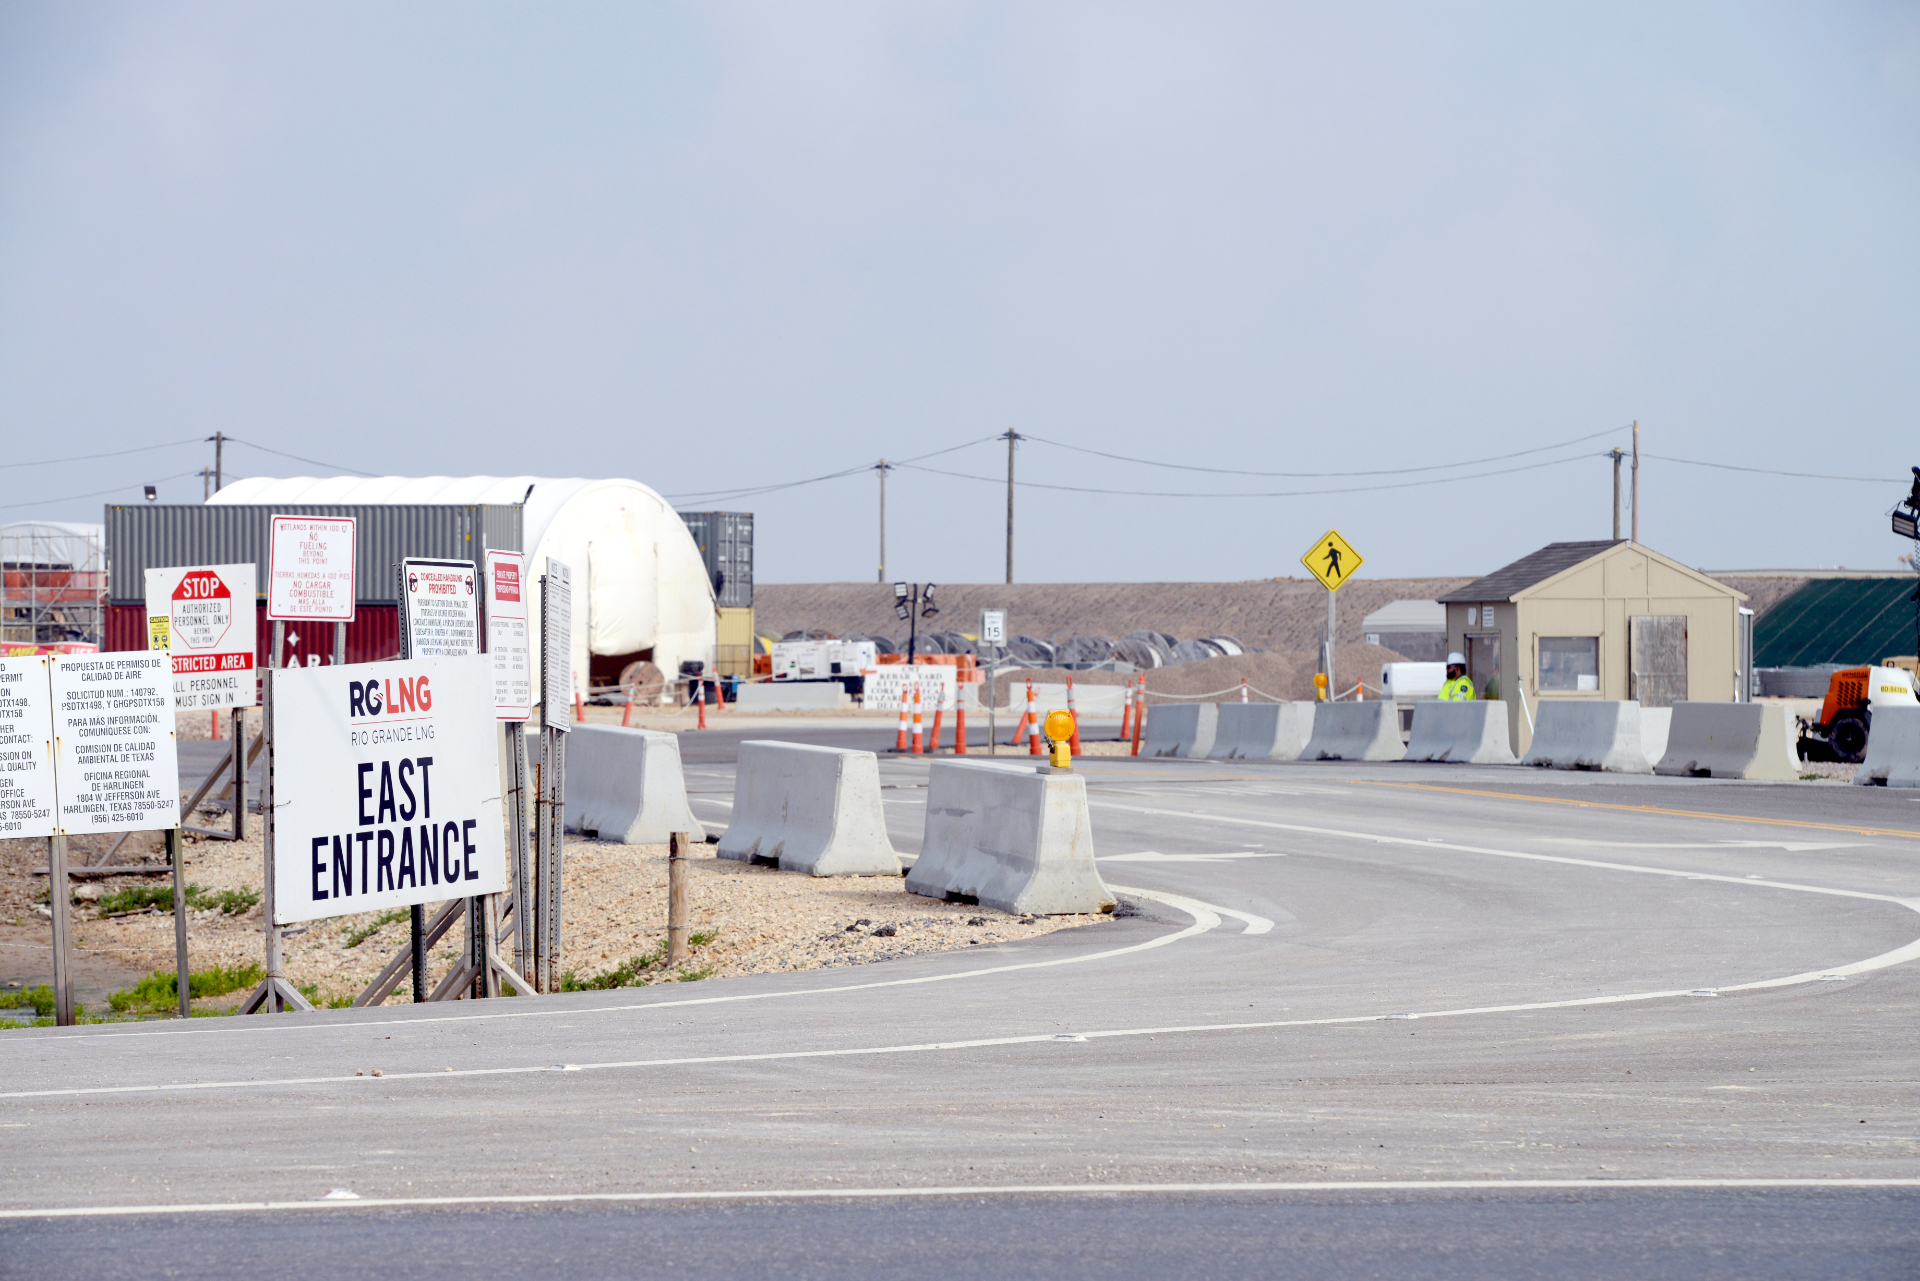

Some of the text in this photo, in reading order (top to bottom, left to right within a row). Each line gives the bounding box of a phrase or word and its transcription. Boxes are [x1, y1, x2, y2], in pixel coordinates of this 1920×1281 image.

[300, 542, 327, 551] FUELING
[183, 577, 220, 598] STOP
[305, 581, 331, 589] CARGAR
[428, 584, 456, 594] PROHIBITED
[289, 590, 334, 598] COMBUSTIBLE
[182, 603, 222, 614] AUTHORIZED
[174, 614, 229, 627] PERSONNEL ONLY
[987, 627, 1000, 638] 15
[61, 659, 161, 672] PROPUESTA DE PERMISO DE
[221, 655, 246, 669] AREA
[82, 671, 142, 681] CALIDAD DE AIRE
[190, 677, 239, 692] PERSONNEL
[66, 690, 104, 700] SOLICITUD
[131, 688, 158, 697] 140792,
[176, 692, 234, 708] MUST SIGN IN
[62, 698, 165, 711] PSDTX1498, Y GHGPSDTX158
[68, 713, 160, 727] PARA MÁS INFORMACIÓN,
[79, 725, 151, 737] COMUNÍQUESE CON:
[351, 725, 435, 746] RIO GRANDE LNG
[76, 742, 156, 754] COMISION DE CALIDAD
[22, 751, 32, 760] ON
[78, 753, 154, 764] AMBIENTAL DE TEXAS
[7, 761, 36, 771] QUALITY
[84, 770, 150, 781] OFICINA REGIONAL
[92, 780, 144, 791] DE HARLINGEN
[358, 756, 433, 826] EAST
[1, 789, 24, 798] OFFICE
[77, 794, 93, 802] 1804
[104, 791, 144, 801] JEFFERSON
[146, 790, 160, 798] AVE
[23, 799, 36, 808] AVE
[64, 800, 174, 814] HARLINGEN, TEXAS 78550-5247
[11, 809, 50, 820] 78550-5247
[92, 812, 143, 825] (956) 425-6010
[312, 819, 479, 901] ENTRANCE
